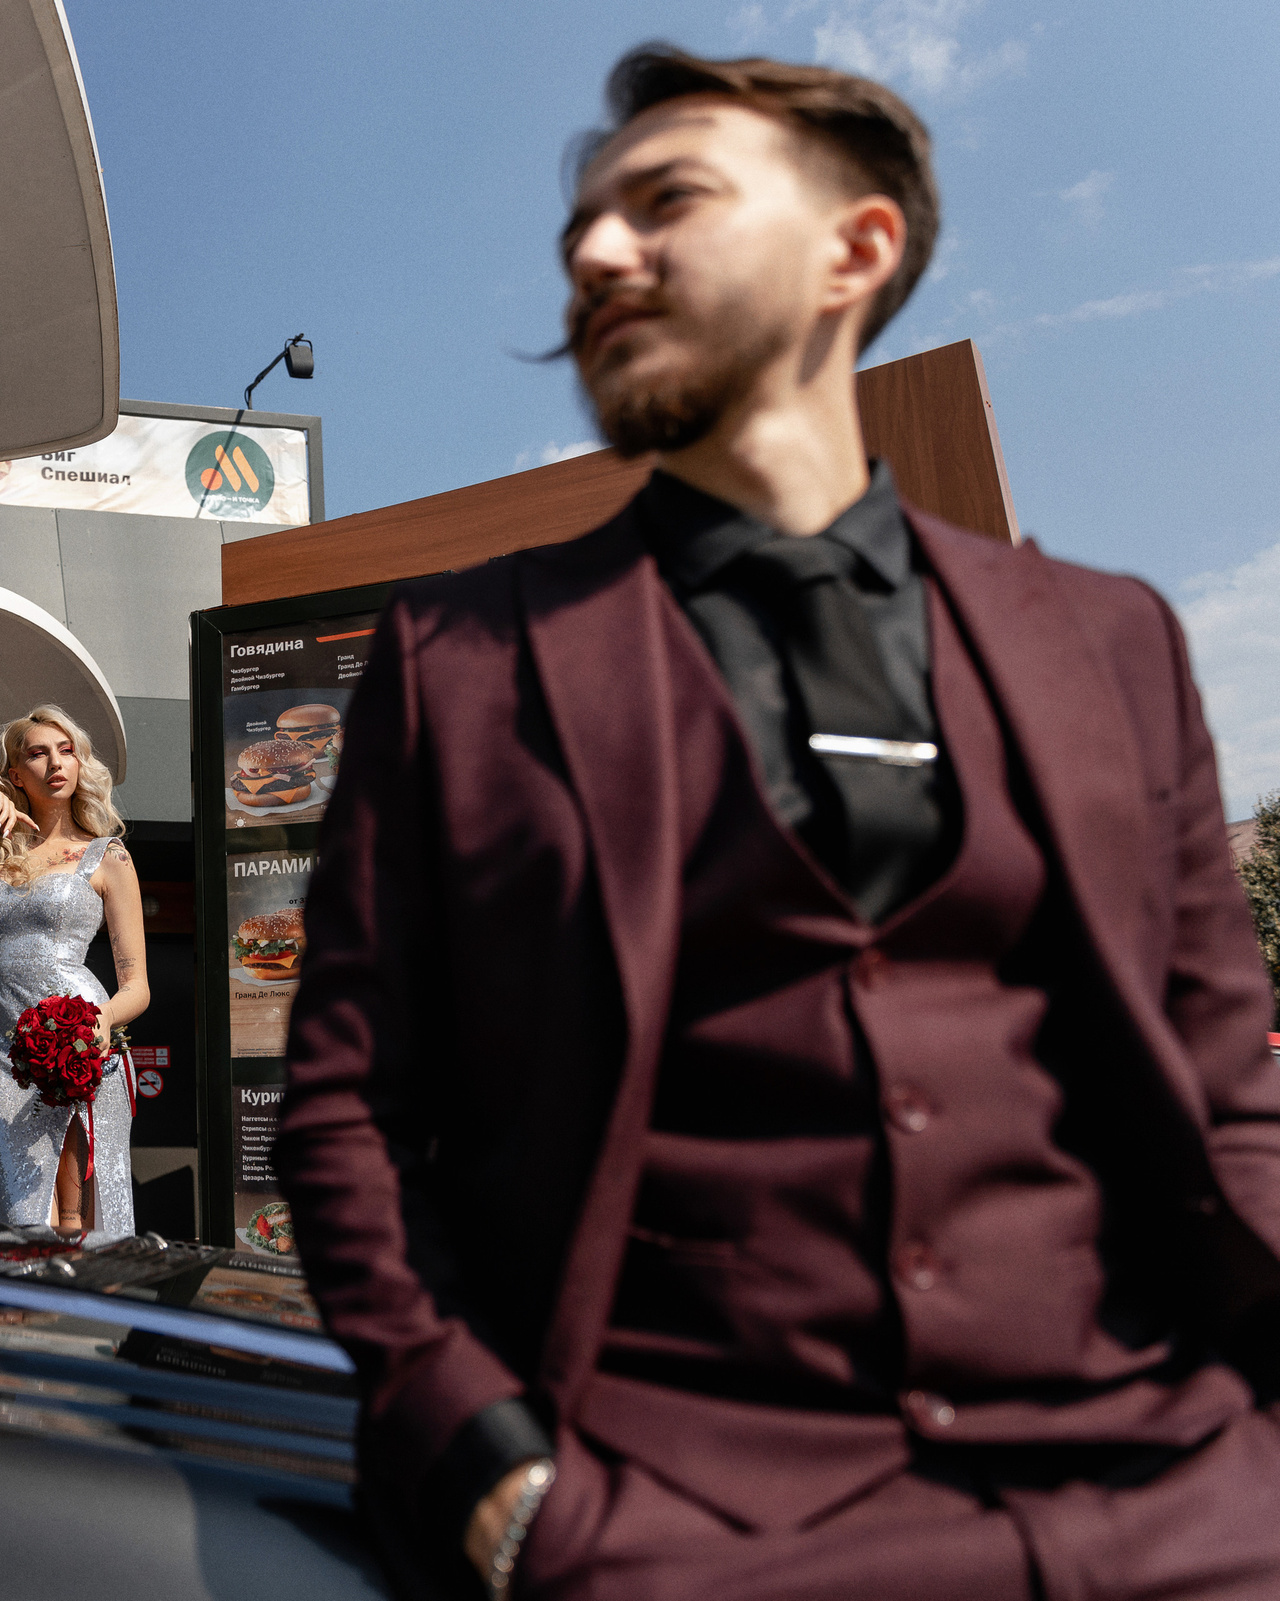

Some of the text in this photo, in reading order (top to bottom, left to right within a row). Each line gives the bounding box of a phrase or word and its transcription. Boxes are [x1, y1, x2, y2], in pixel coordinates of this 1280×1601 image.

[40, 466, 131, 486] Спешиал
[230, 639, 304, 658] Говядина
[231, 666, 259, 674] Чизбургер
[338, 663, 354, 671] Гранд
[231, 672, 285, 684] Двойной Чизбургер
[338, 671, 363, 679] Двойной
[231, 683, 260, 692] Гамбургер
[246, 726, 271, 734] Чизбургер
[234, 857, 311, 878] ПАРАМИ
[235, 991, 257, 1000] Гранд
[270, 990, 290, 998] Люкс
